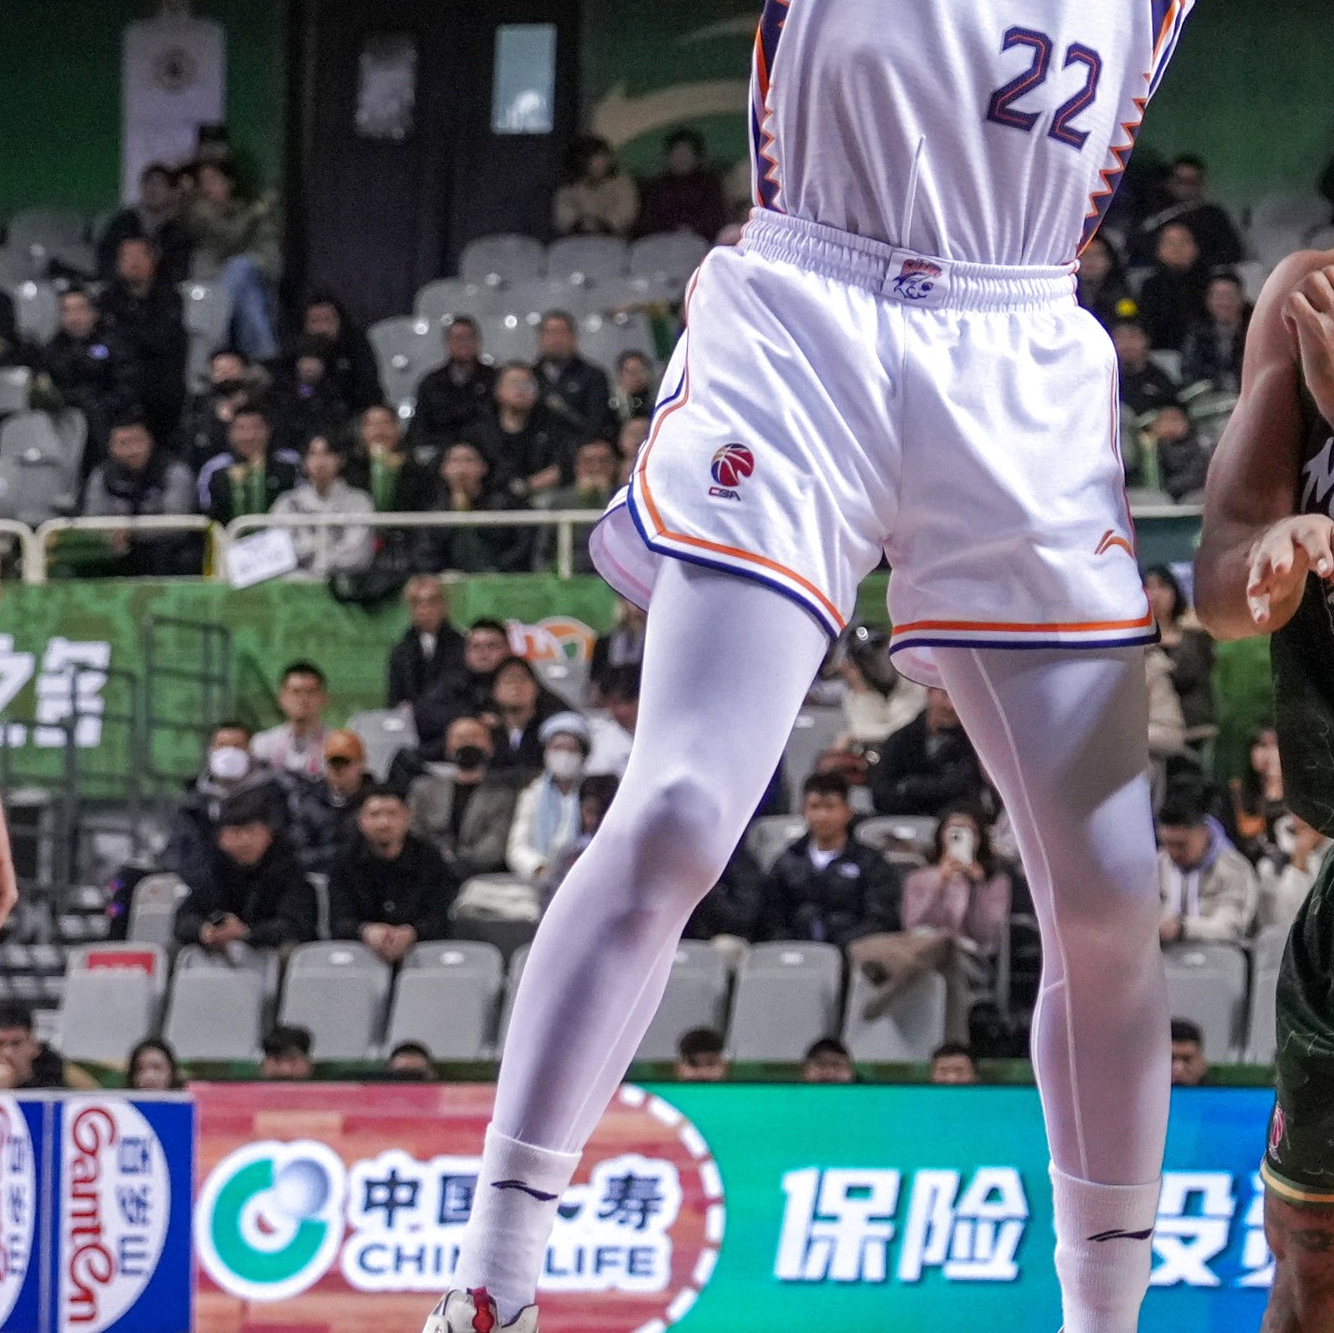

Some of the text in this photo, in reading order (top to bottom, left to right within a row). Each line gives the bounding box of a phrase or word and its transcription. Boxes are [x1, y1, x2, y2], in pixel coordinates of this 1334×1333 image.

[986, 26, 1104, 151] 22
[544, 1244, 657, 1277] LIFE
[774, 1166, 1029, 1282] 保险
